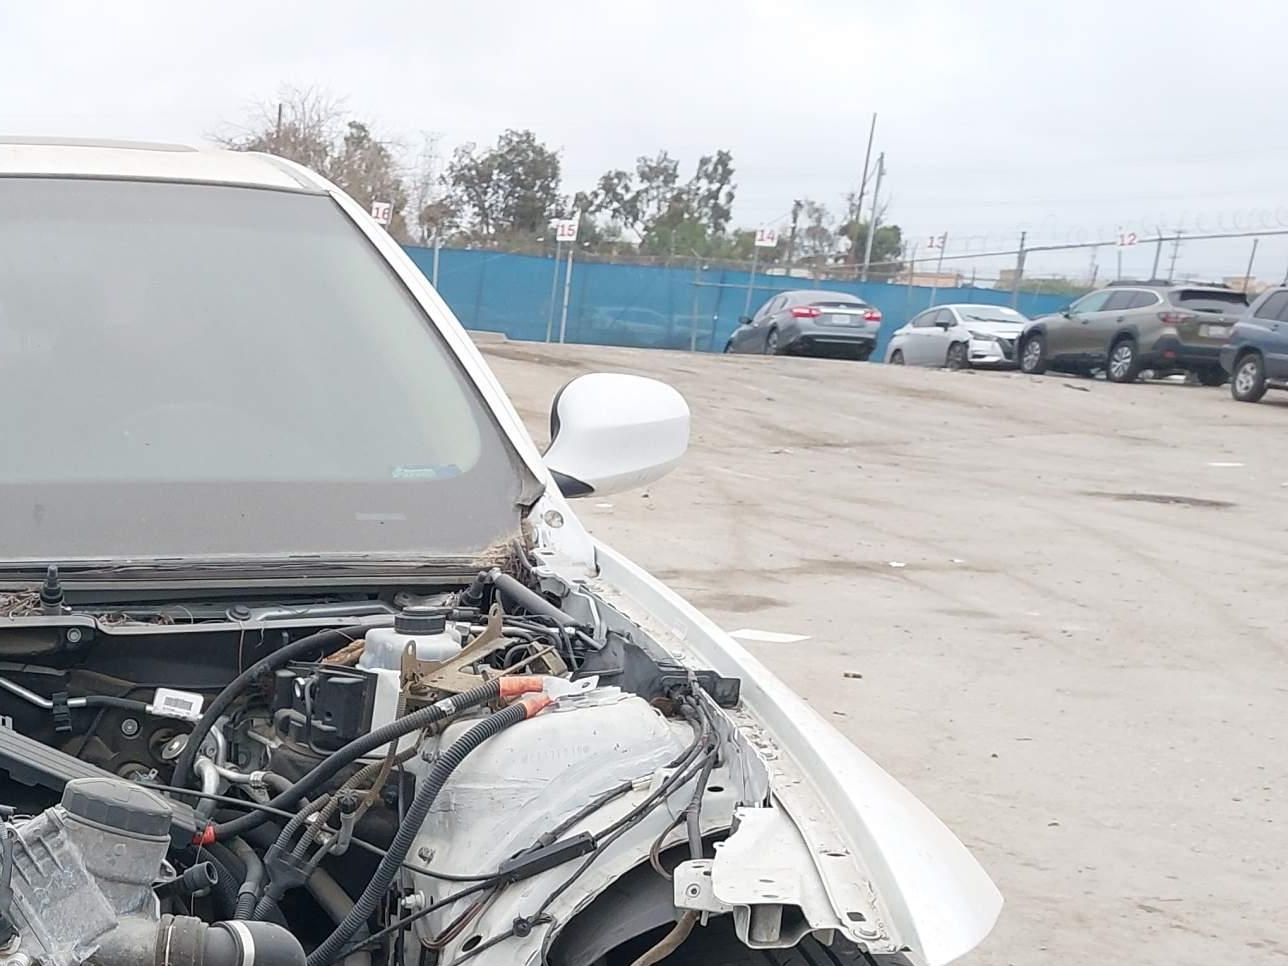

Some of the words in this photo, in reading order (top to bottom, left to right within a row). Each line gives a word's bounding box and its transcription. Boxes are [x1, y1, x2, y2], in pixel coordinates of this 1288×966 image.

[558, 224, 576, 237] 15
[758, 229, 776, 242] 14
[927, 236, 945, 248] 13
[1119, 232, 1137, 246] 12
